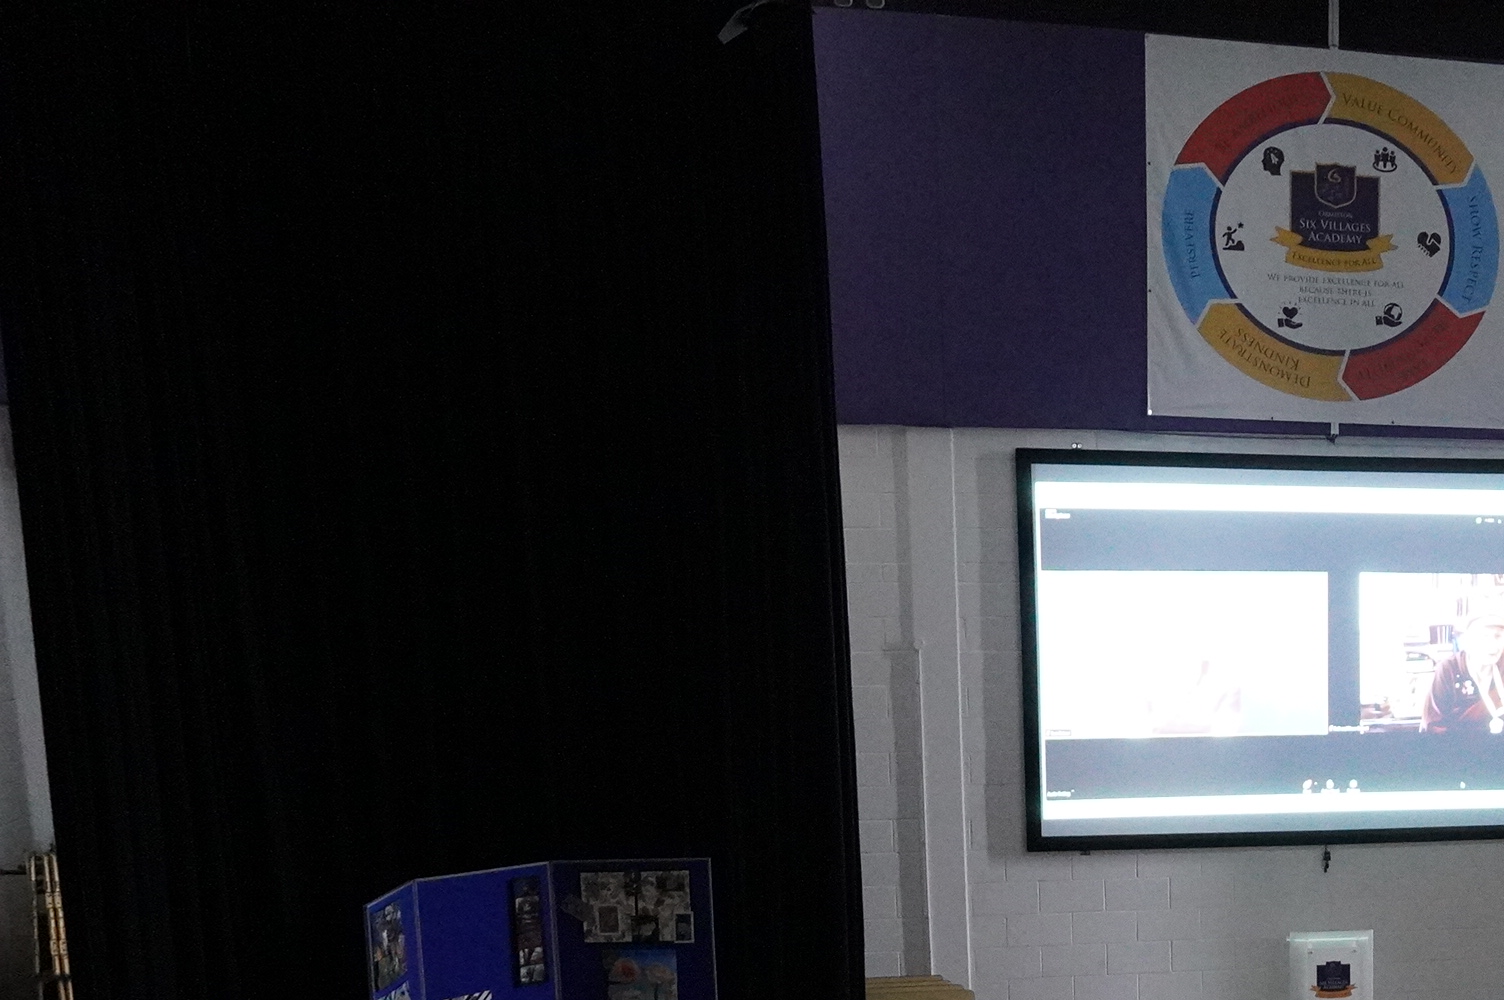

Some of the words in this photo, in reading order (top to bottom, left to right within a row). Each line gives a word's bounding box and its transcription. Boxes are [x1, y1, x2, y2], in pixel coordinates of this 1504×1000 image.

[1342, 92, 1384, 114] VALUE
[1387, 107, 1459, 174] COMMUNITY
[1300, 218, 1316, 229] SIX
[1320, 219, 1371, 233] VILLAGES
[1308, 231, 1362, 244] ACADEMY
[1468, 195, 1482, 239] SHOW
[1182, 208, 1201, 279] PERSEVERE
[1461, 245, 1483, 302] RESPECT
[1216, 329, 1312, 388] DEMONSTRATE
[1236, 327, 1300, 370] KINDNESS
